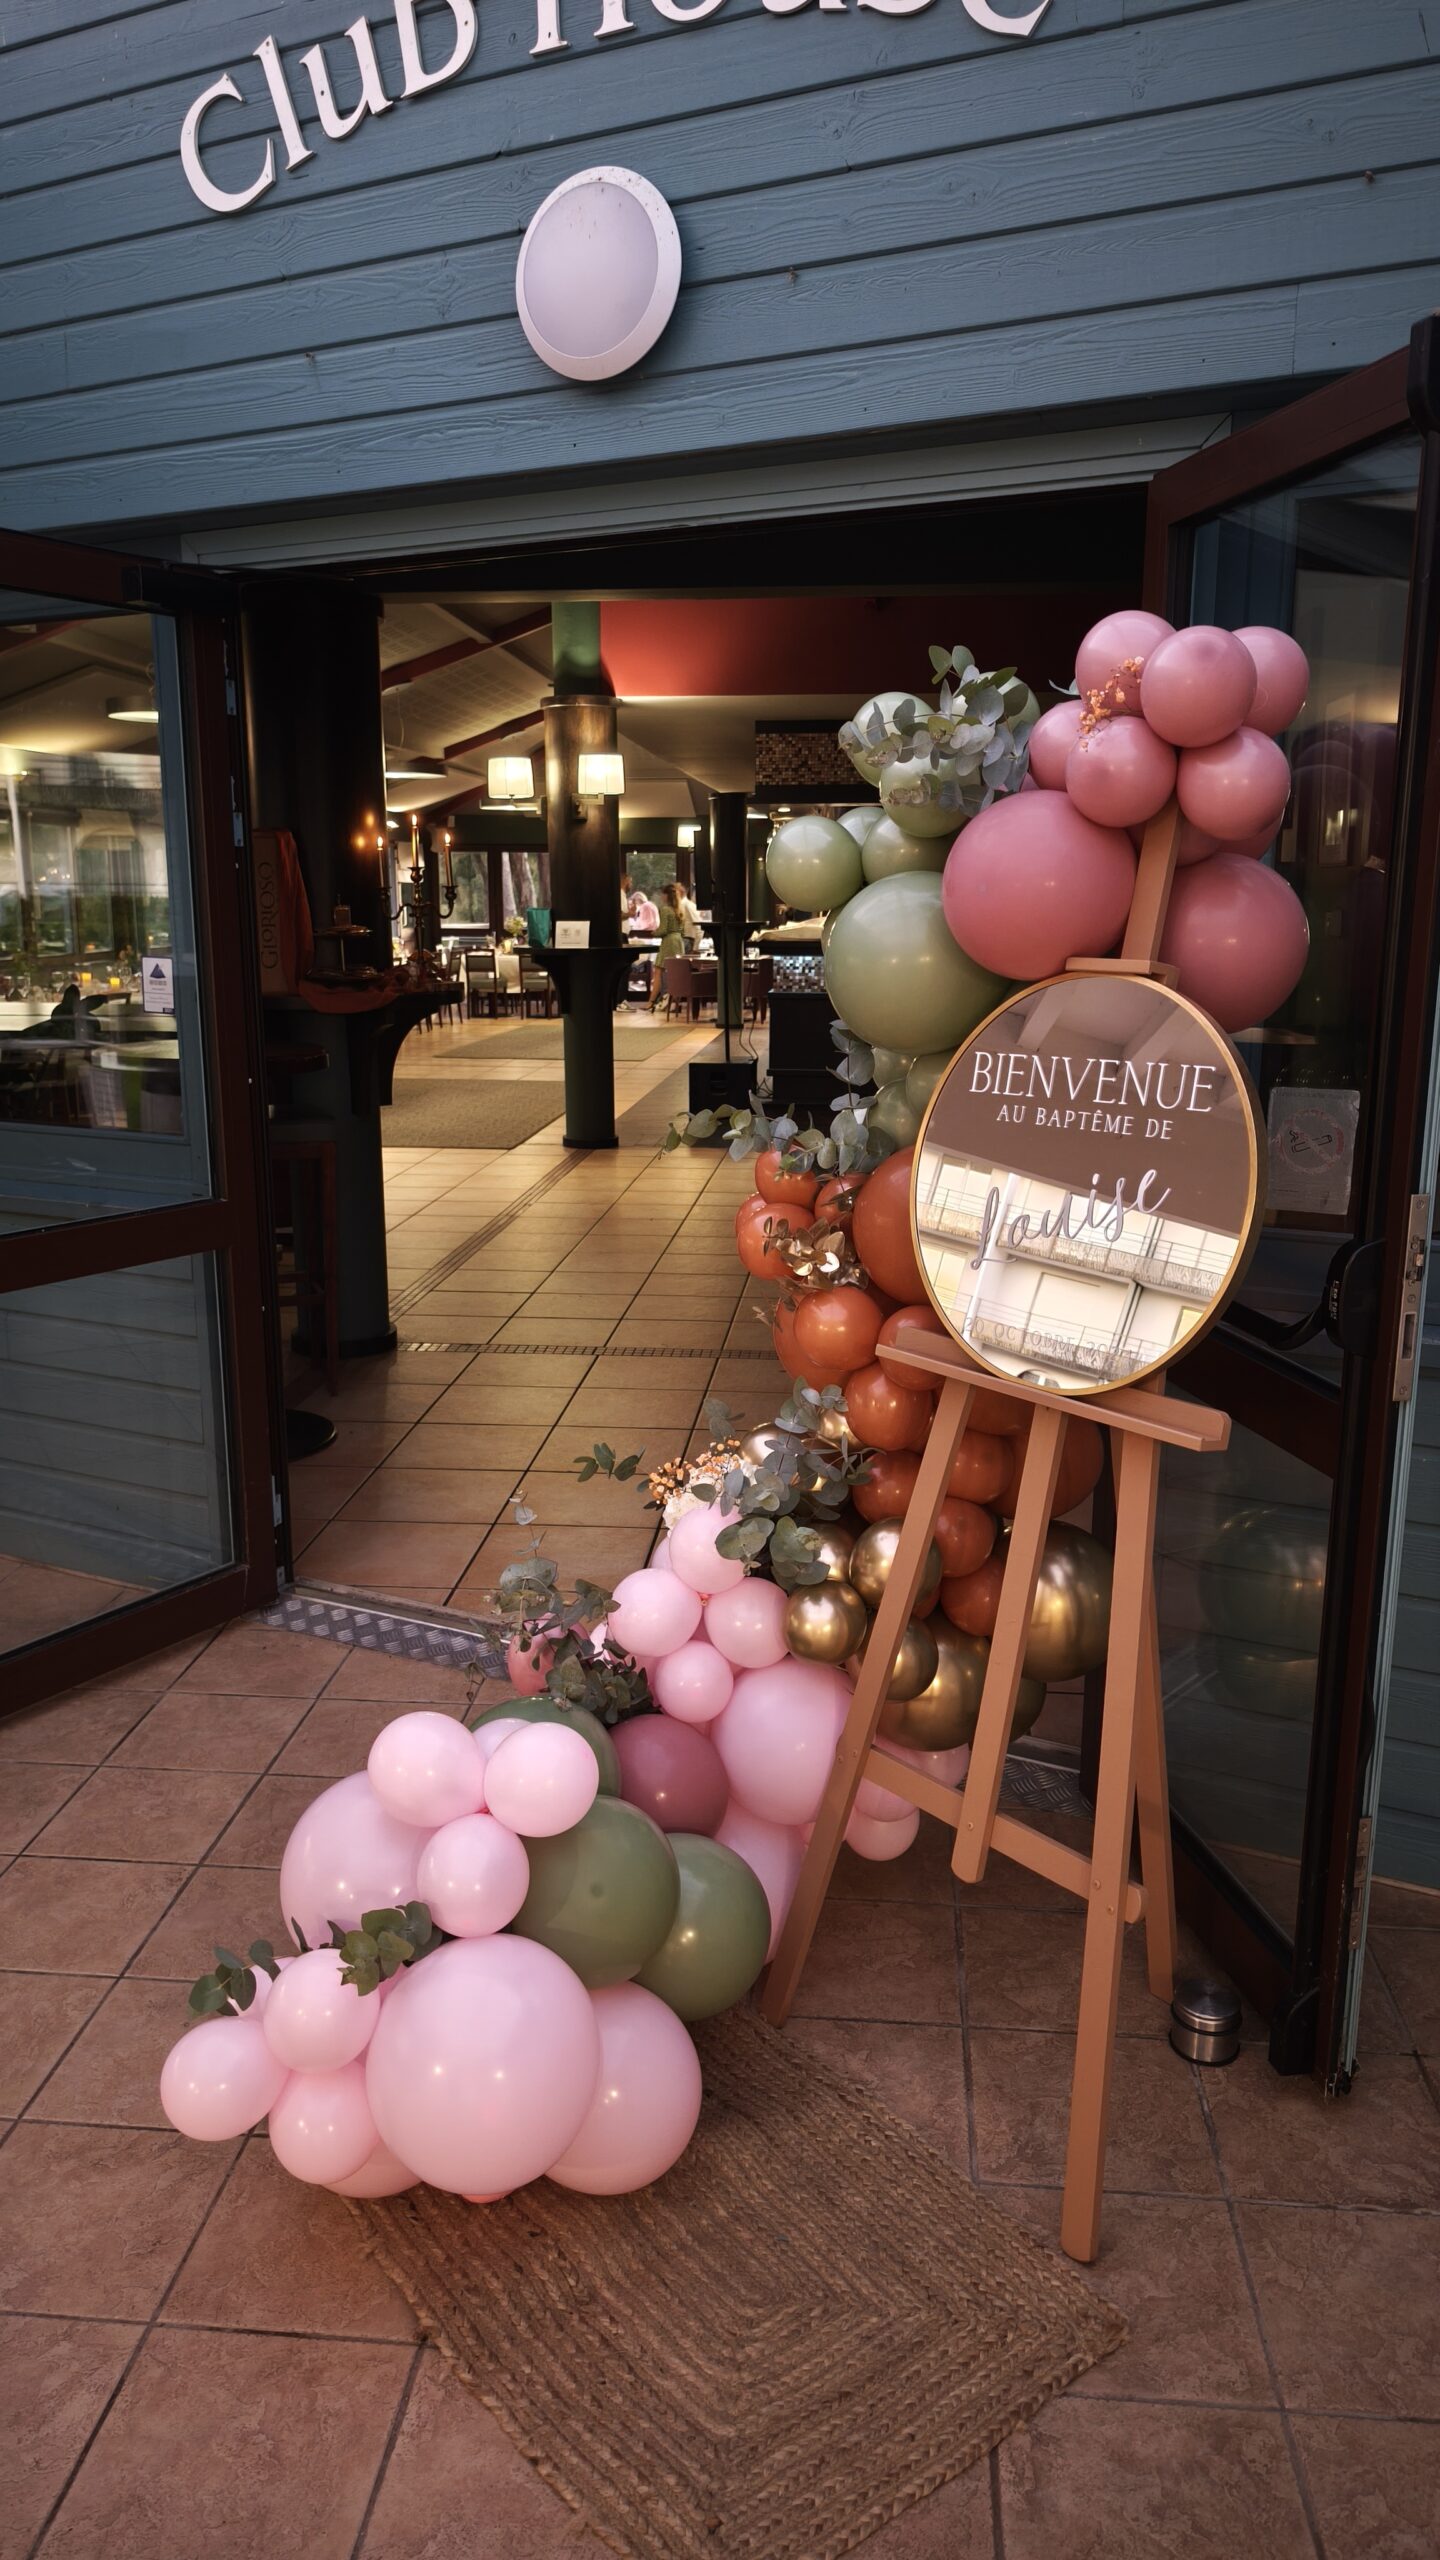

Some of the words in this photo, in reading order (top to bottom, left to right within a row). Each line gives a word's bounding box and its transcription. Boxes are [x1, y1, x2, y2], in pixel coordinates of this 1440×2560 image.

[969, 1051, 1218, 1113] BIENVENUE
[996, 1104, 1027, 1124] AU
[1035, 1106, 1136, 1136] BAPTÊME
[1144, 1118, 1174, 1141] DE
[970, 1169, 1173, 1271] Louise
